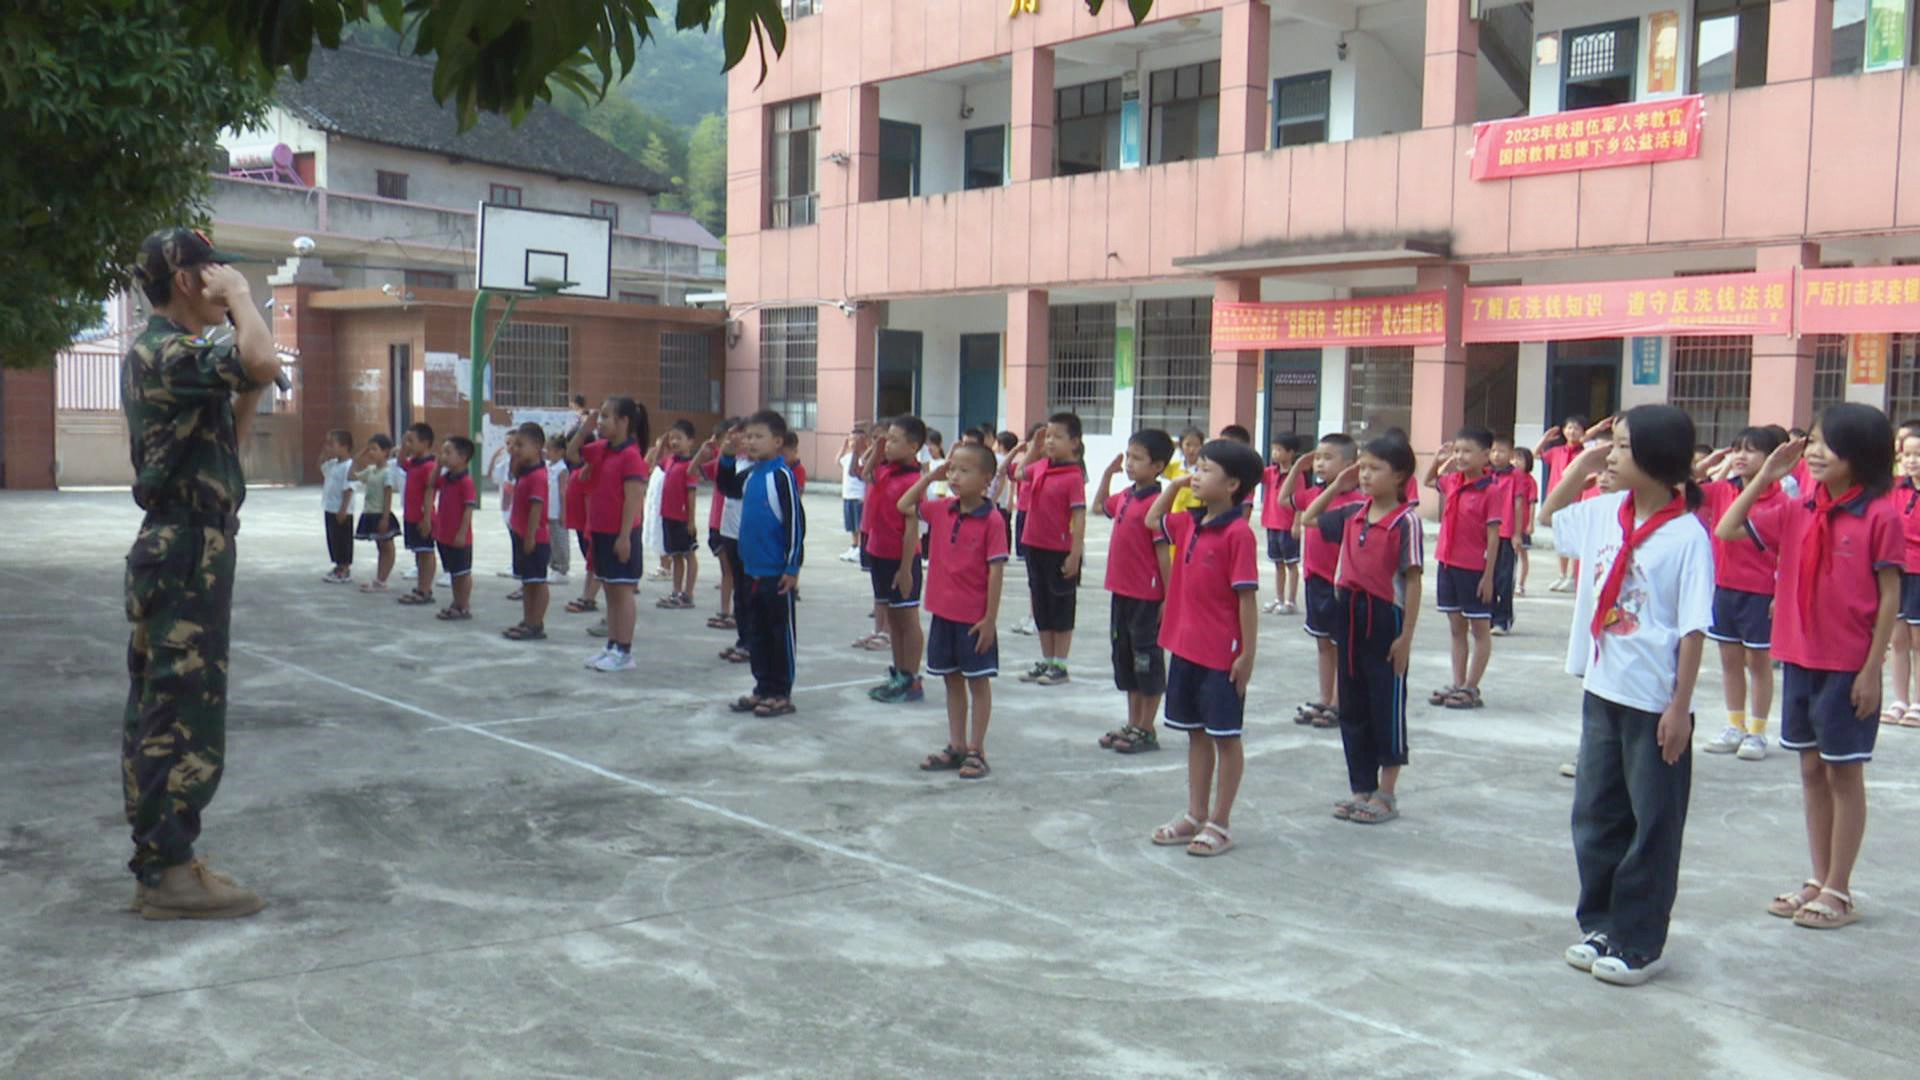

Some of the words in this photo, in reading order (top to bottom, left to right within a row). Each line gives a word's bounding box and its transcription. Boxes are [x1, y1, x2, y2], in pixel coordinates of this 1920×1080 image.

[1505, 109, 1684, 144] 2023年秋退伍军人李教官
[1498, 131, 1688, 166] 国防教育送课下乡公益活动
[1471, 293, 1604, 321] 了解反洗钱知识
[1627, 283, 1785, 317] 遵守反洗钱法规
